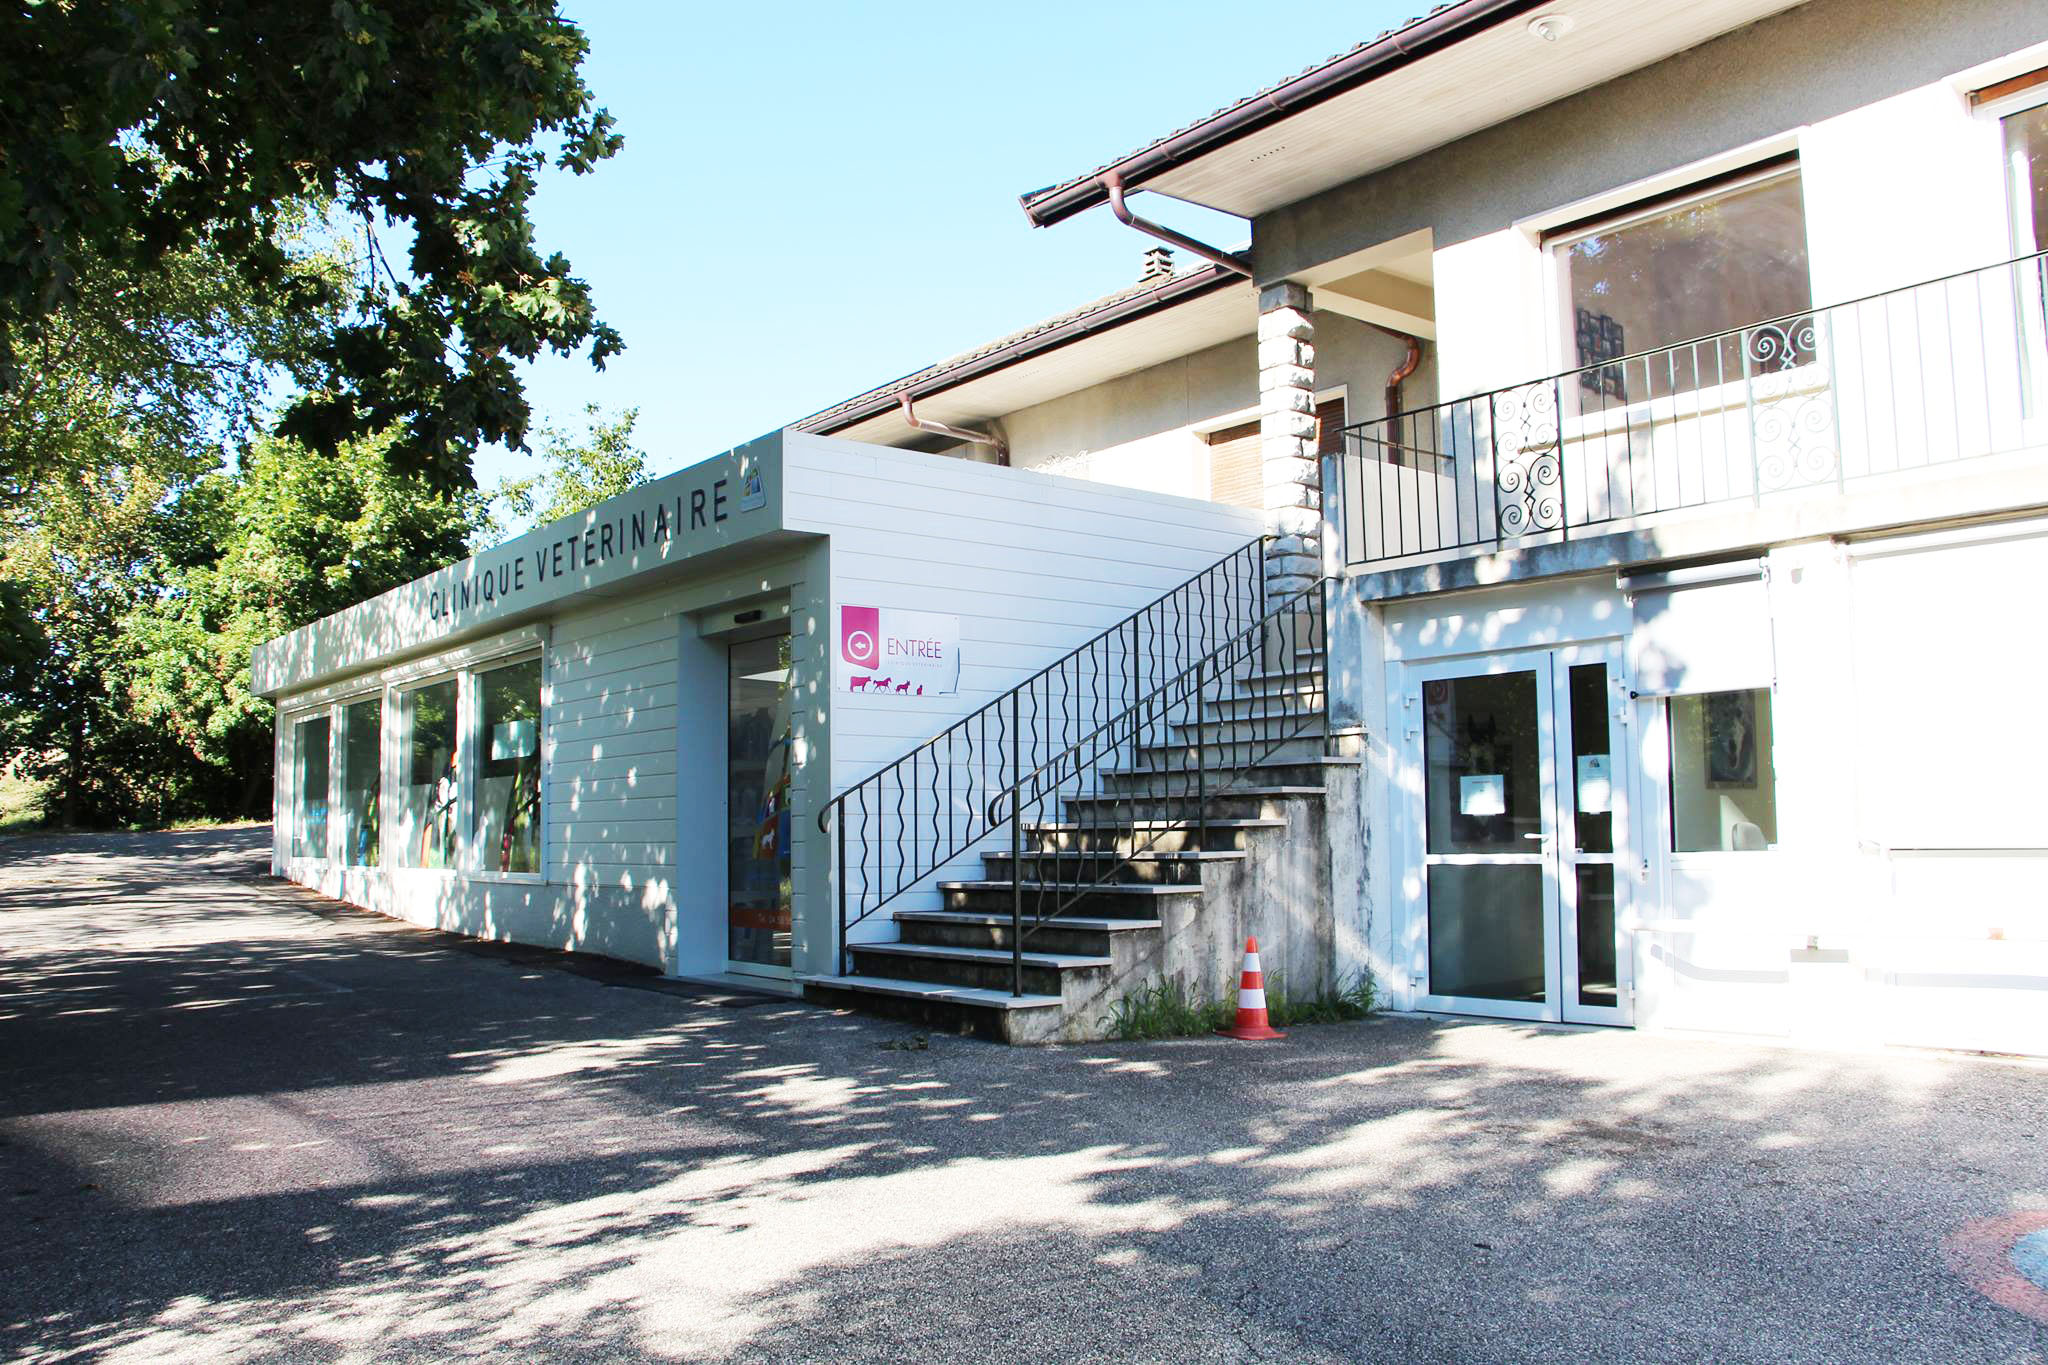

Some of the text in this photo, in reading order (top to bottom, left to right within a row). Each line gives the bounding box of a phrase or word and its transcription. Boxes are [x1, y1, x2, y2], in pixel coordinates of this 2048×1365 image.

[430, 479, 727, 620] CLINIQUE VETERINAIRE
[887, 637, 942, 659] ENTRÉE
